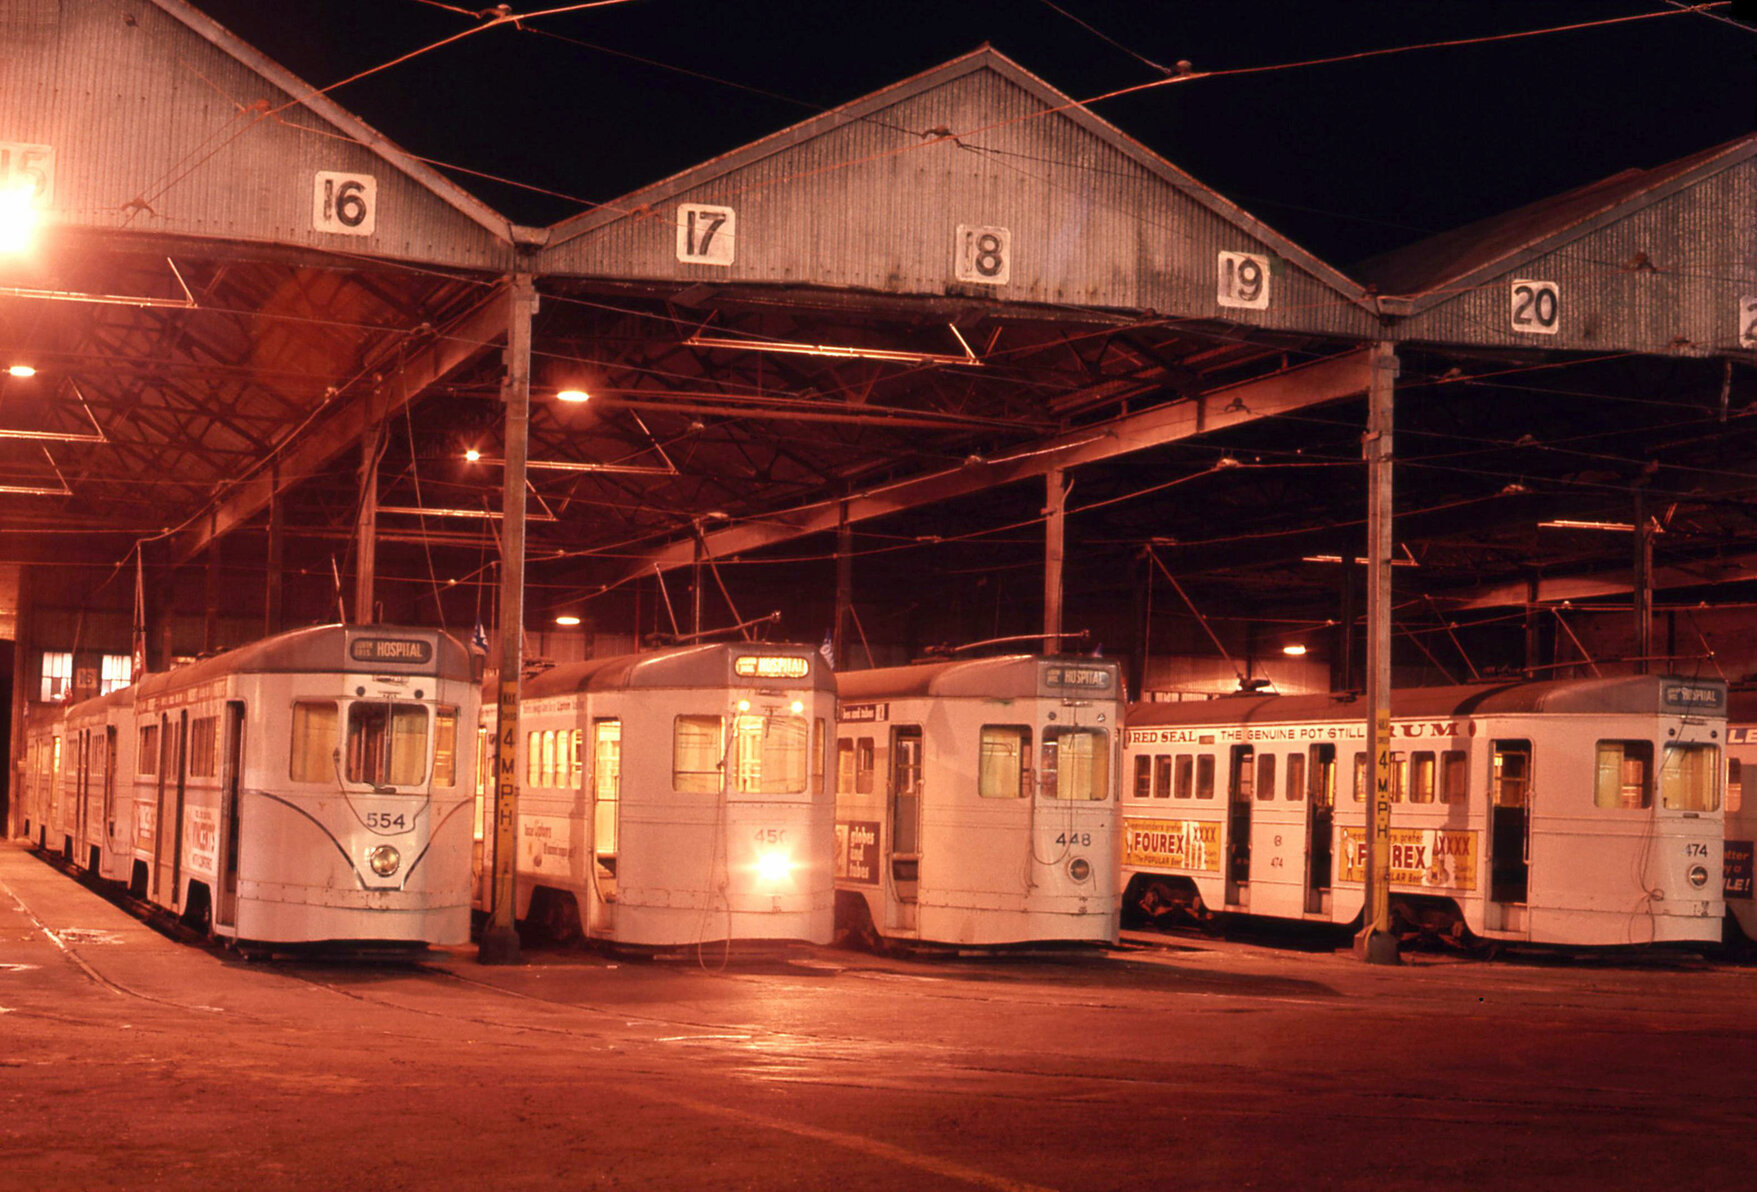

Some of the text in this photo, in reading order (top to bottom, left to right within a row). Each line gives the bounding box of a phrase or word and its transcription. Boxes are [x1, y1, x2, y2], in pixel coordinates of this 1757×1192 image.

[323, 179, 367, 228] 16
[687, 210, 727, 256] 17
[966, 230, 1003, 277] 18
[1226, 257, 1263, 301] 19
[1514, 285, 1558, 327] 20
[377, 641, 423, 658] HOSPITAL
[758, 657, 804, 674] HOSPITAL
[1064, 669, 1105, 686] HOSPITAL
[503, 728, 515, 748] 4
[1133, 730, 1197, 743] RED SEAL
[1221, 727, 1365, 740] THE GENUINE POT STILL
[1379, 750, 1388, 769] 4
[367, 812, 405, 829] 554
[1056, 832, 1091, 847] 448
[1134, 832, 1184, 855] FOUREX
[1193, 826, 1216, 842] XXXX
[1439, 836, 1470, 855] XXXX
[1686, 843, 1708, 857] 474
[1357, 843, 1426, 869] FREX
